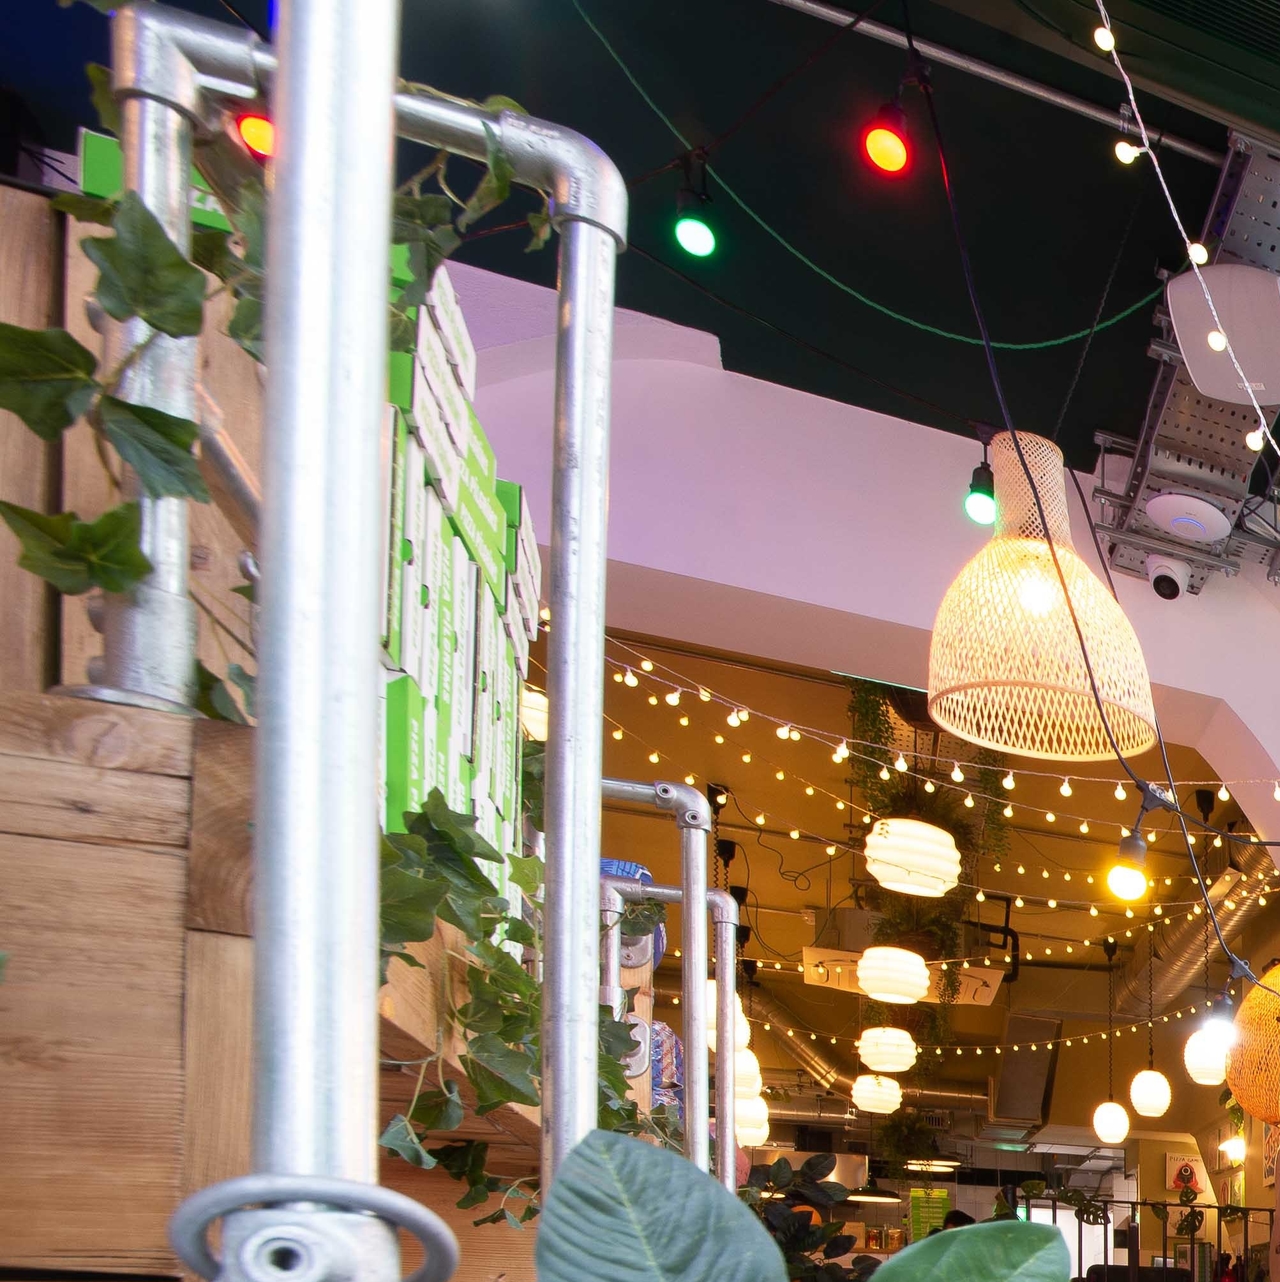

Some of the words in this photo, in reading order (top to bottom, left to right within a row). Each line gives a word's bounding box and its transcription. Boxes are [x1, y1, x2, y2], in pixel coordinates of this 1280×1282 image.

[442, 544, 452, 602] PIZZA
[442, 606, 452, 705] PiLGRiMS
[410, 717, 419, 781] PIZZA
